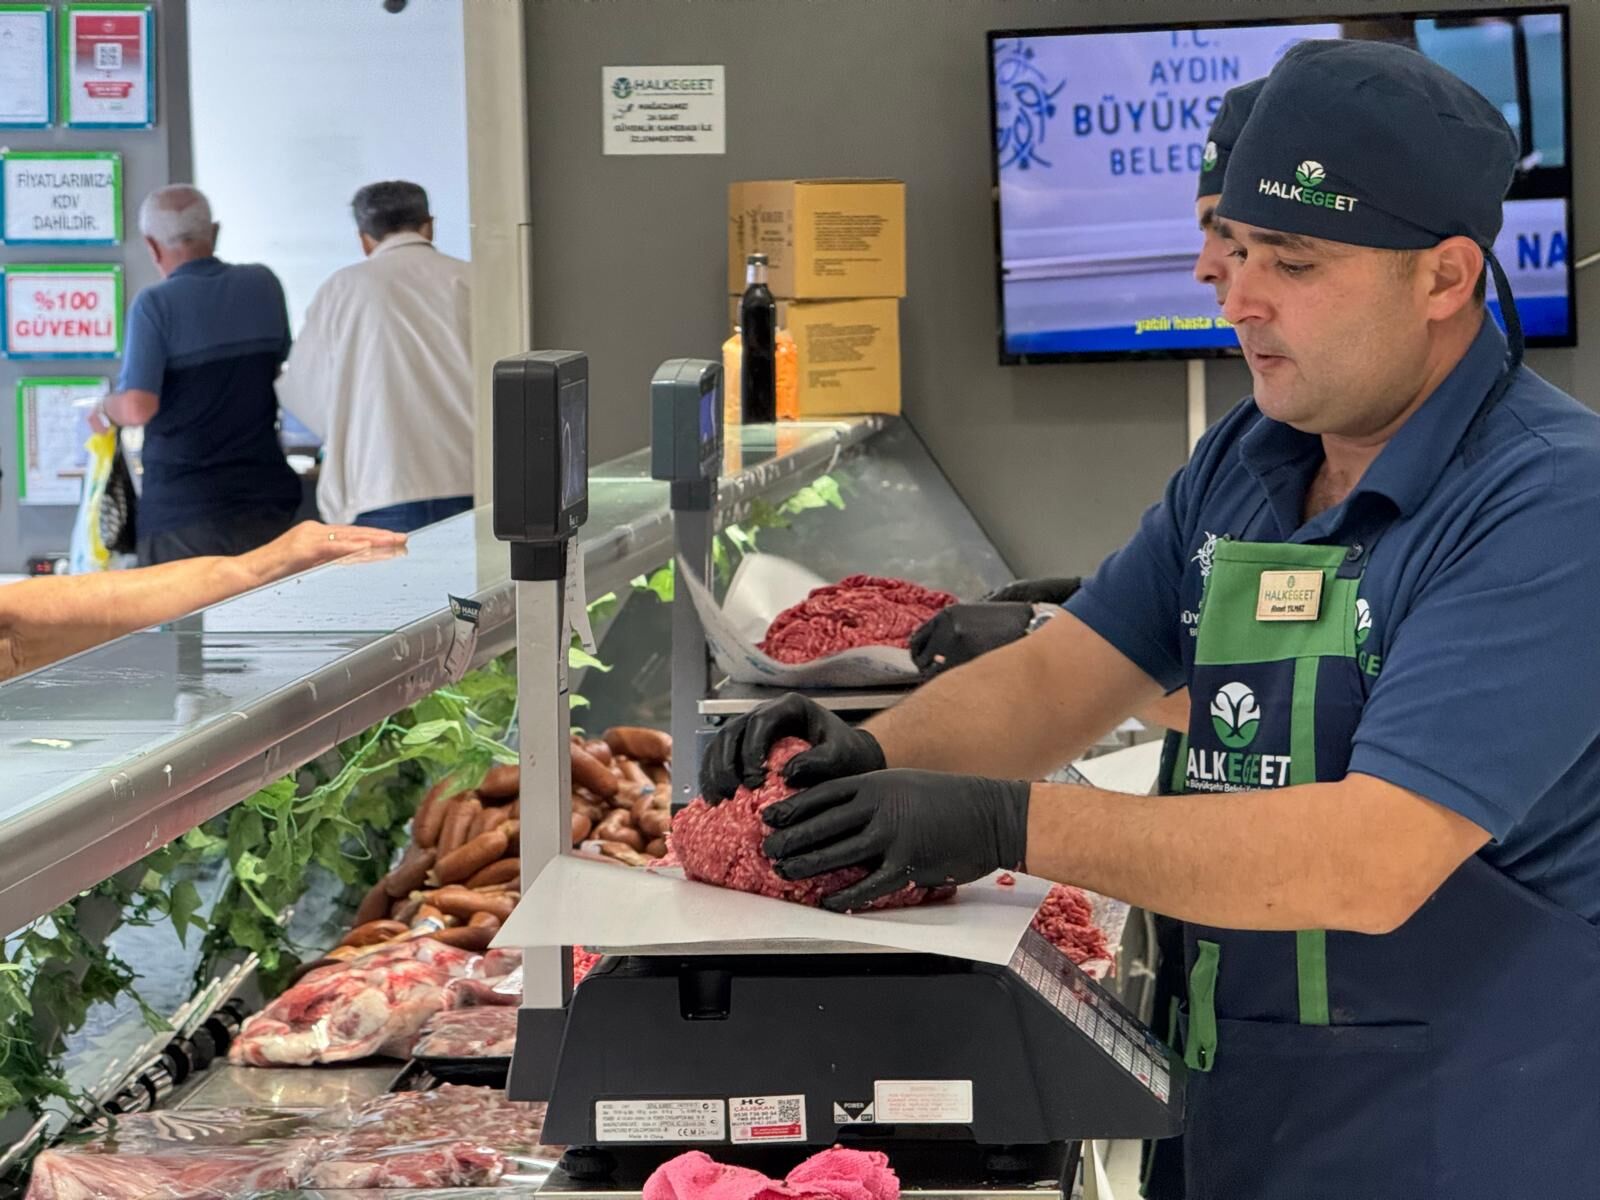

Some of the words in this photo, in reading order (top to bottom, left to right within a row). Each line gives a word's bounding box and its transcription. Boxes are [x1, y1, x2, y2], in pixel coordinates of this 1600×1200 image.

[1150, 56, 1240, 85] AYDIN
[633, 79, 714, 91] HALKEGEET
[52, 194, 79, 209] KDV
[1259, 178, 1359, 212] HALKEGEET
[34, 290, 98, 310] %100
[1264, 589, 1315, 601] HALKEGEET
